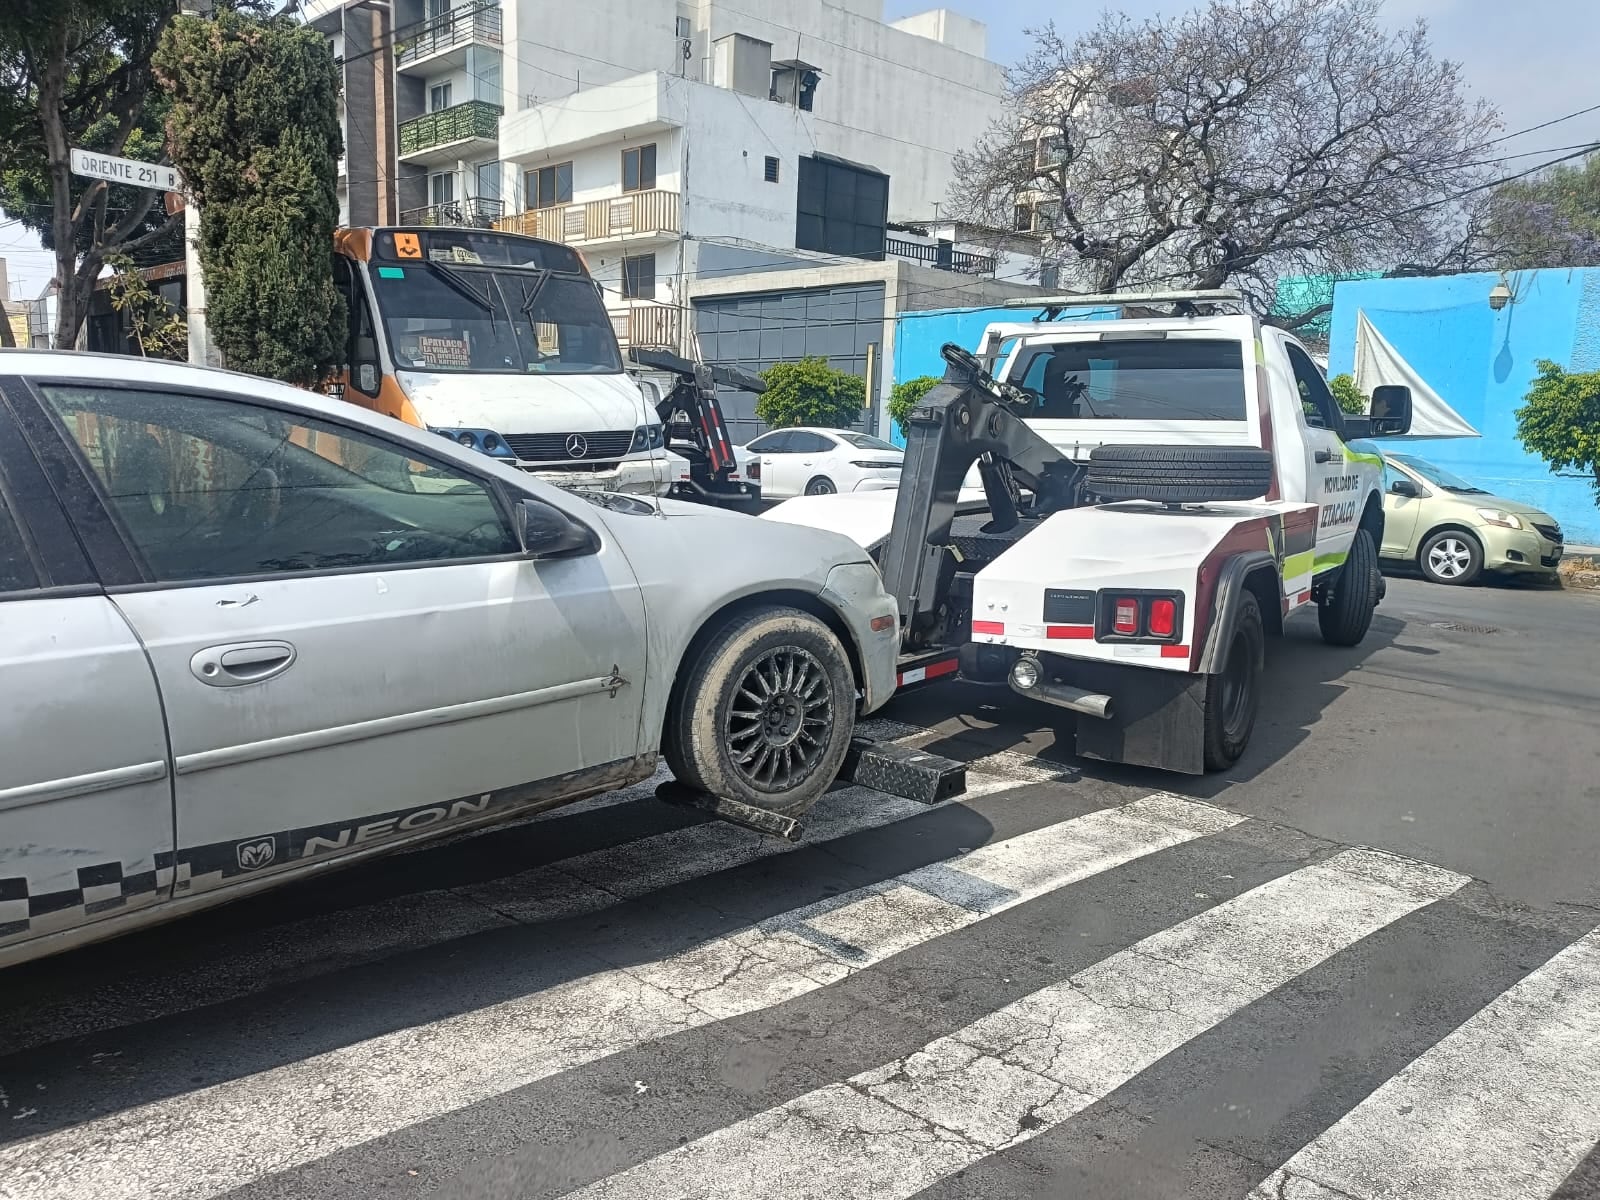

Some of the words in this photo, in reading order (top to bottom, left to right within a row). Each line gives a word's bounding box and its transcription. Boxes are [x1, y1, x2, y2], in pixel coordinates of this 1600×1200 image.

[82, 155, 132, 178] ORIENTE
[138, 167, 157, 184] 251
[168, 173, 175, 186] B
[1324, 475, 1351, 494] MOVILIDAD
[1351, 474, 1359, 490] DE
[1320, 500, 1356, 529] IZTACALCO
[302, 794, 491, 858] NEON
